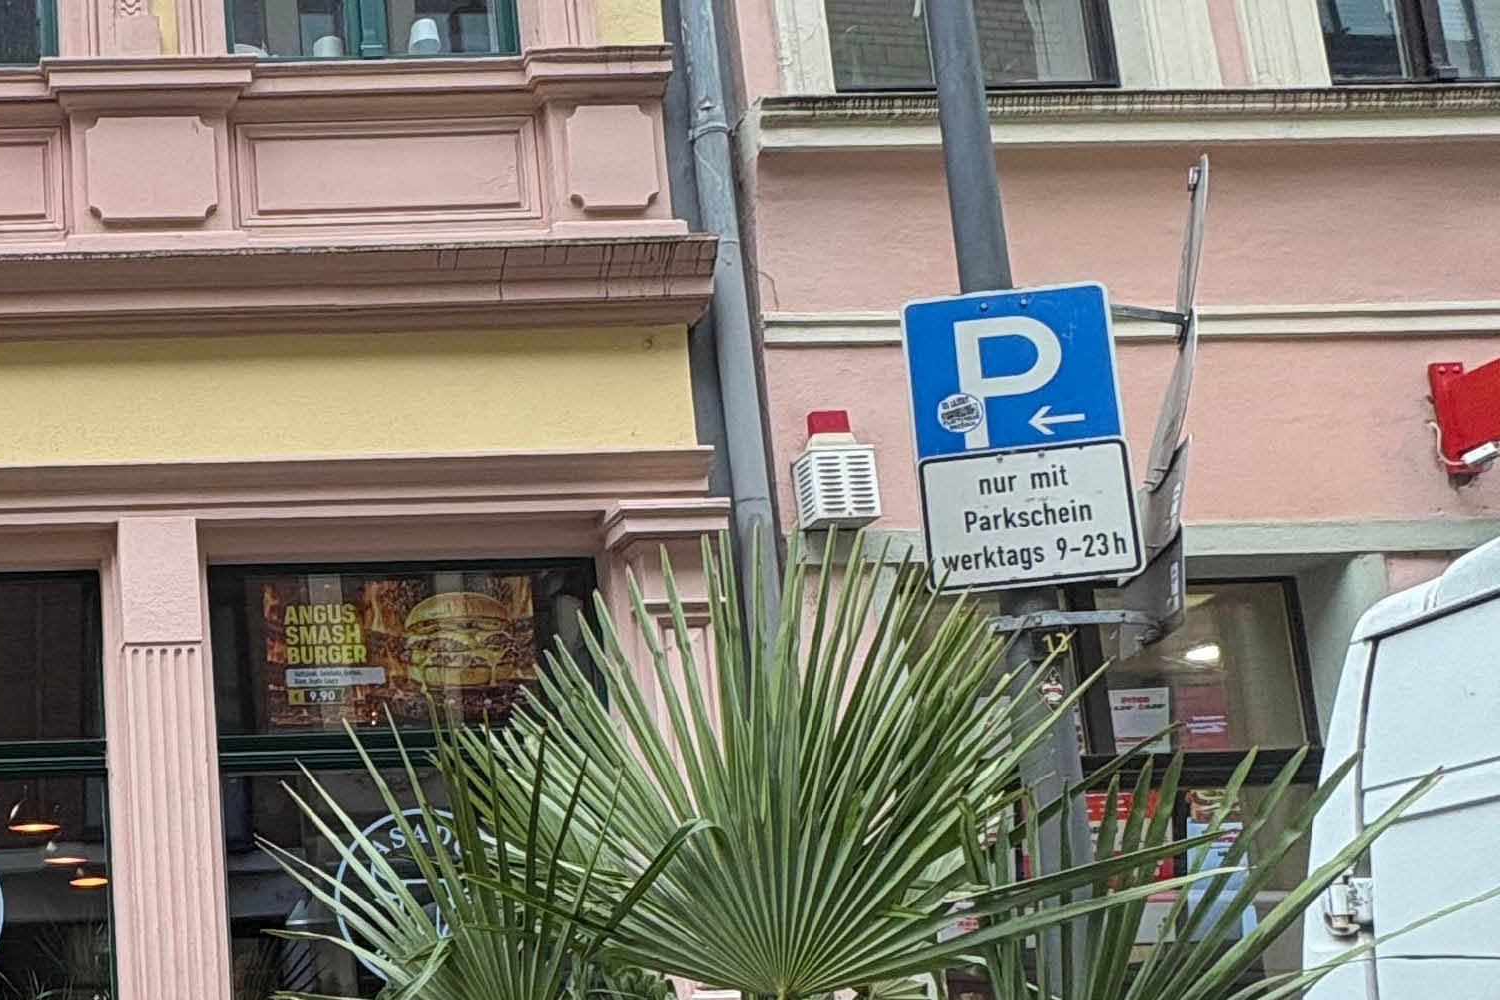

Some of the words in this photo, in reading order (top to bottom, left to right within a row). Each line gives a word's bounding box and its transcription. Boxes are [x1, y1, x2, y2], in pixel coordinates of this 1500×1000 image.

[953, 315, 1062, 449] P
[979, 474, 1017, 495] nur
[1030, 464, 1068, 489] mit
[964, 499, 1092, 533] Parkschein
[942, 545, 1045, 572] werktags
[284, 603, 357, 625] ANGUS
[285, 623, 360, 645] SMASH
[287, 644, 367, 665] BURGER
